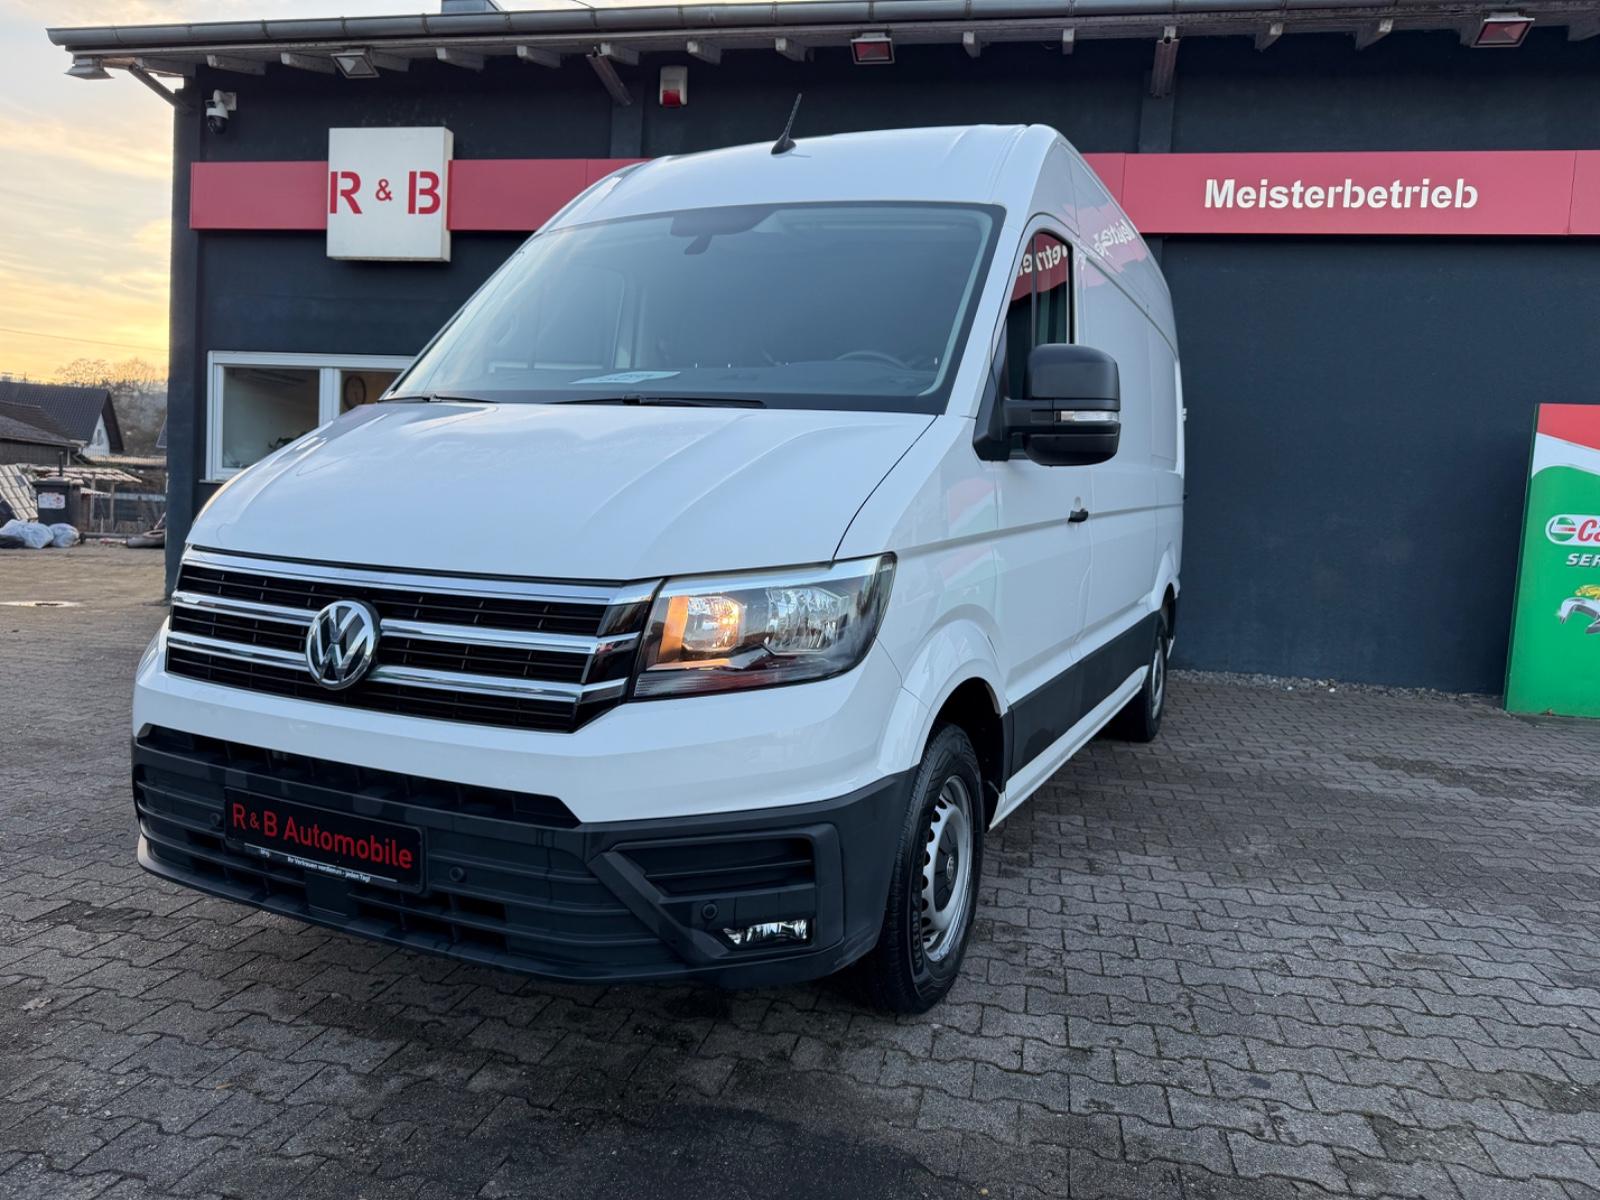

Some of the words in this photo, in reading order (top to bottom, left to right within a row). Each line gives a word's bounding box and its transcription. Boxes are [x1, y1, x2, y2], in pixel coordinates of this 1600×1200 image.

[330, 171, 363, 214] R
[375, 178, 393, 202] &
[408, 171, 441, 214] B
[1204, 178, 1479, 209] Meisterbetrieb
[232, 803, 247, 830] R
[250, 812, 260, 830] &
[263, 810, 278, 837] B
[283, 816, 413, 869] Automobile
